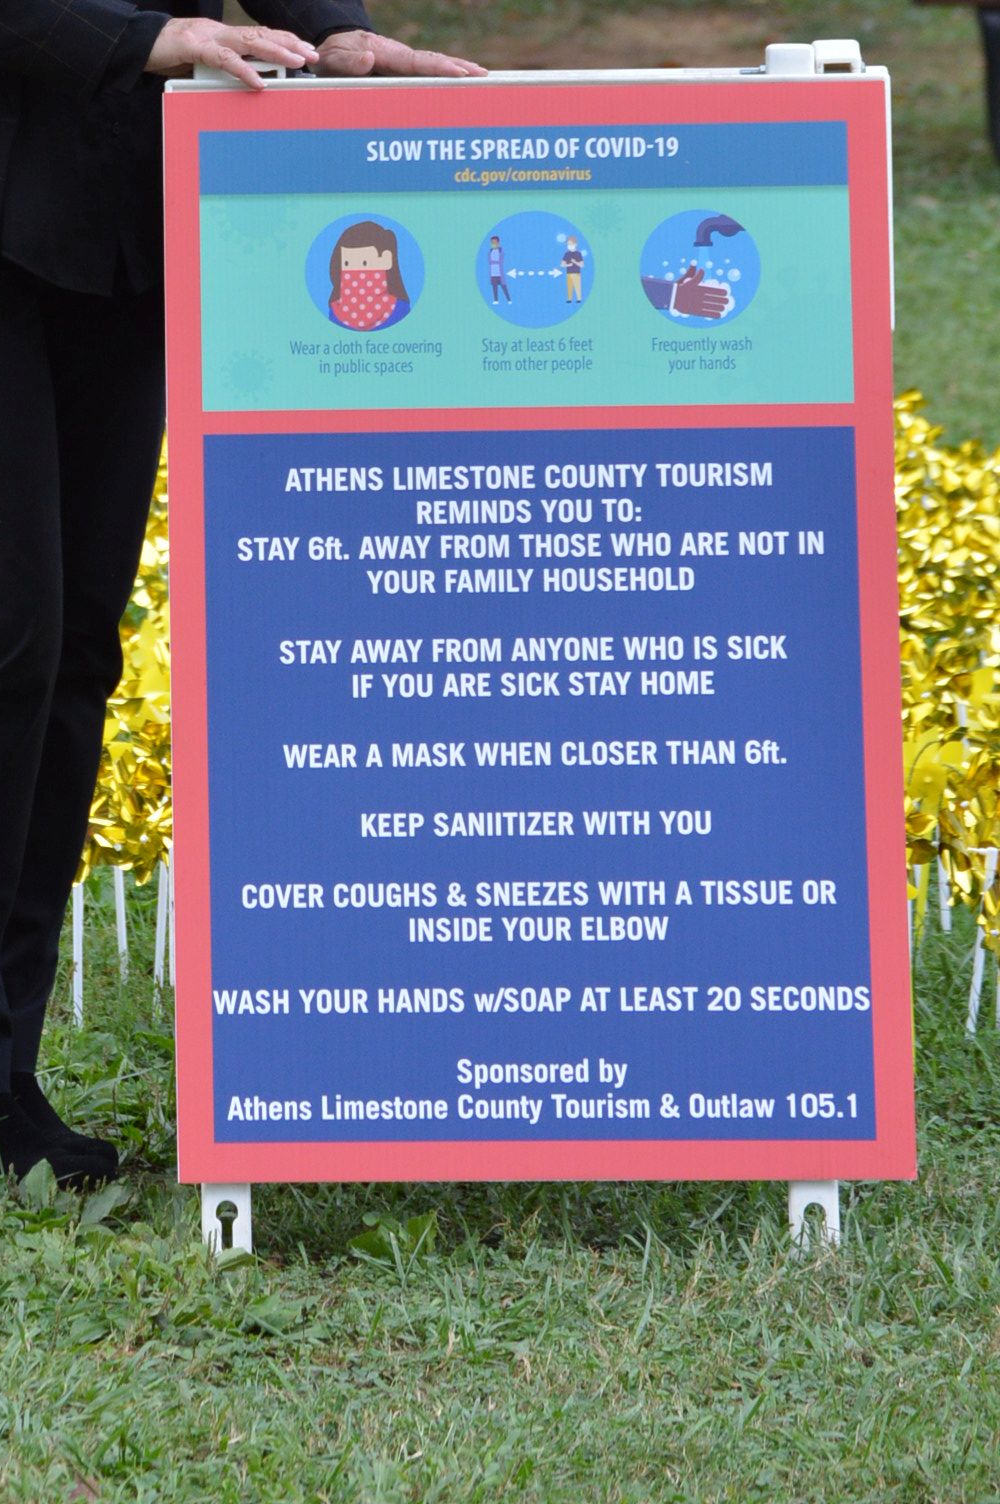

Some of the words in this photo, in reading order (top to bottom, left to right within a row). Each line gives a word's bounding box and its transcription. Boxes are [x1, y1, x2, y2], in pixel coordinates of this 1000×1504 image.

[366, 140, 423, 162] SLOW
[426, 139, 466, 161] THE
[470, 138, 550, 160] SPREAD
[554, 137, 580, 159] OF
[584, 136, 679, 159] COVID-19
[454, 167, 591, 185] cdc.gov/coronavirus
[290, 341, 321, 356] Wear
[324, 344, 330, 355] a
[333, 340, 363, 355] cloth
[365, 340, 390, 354] face
[393, 339, 443, 357] covering
[481, 338, 507, 355] Stay
[511, 340, 523, 353] at
[527, 338, 555, 353] least
[558, 338, 566, 352] 6
[569, 336, 593, 352] feet
[651, 337, 717, 355] Frequently
[720, 336, 753, 351] wash
[319, 360, 331, 374] in
[333, 359, 370, 377] public
[374, 360, 414, 376] spaces
[482, 357, 512, 372] from
[515, 357, 548, 371] other
[551, 357, 593, 374] people
[668, 360, 697, 375] your
[699, 356, 737, 371] hands
[285, 467, 383, 491] ATHENS
[394, 465, 535, 490] LIMESTONE
[545, 464, 647, 488] COUNTY
[656, 463, 772, 487] TOURISM
[417, 500, 531, 524] REMINDS
[541, 499, 592, 523] YOU
[601, 498, 641, 522] TO:
[238, 537, 299, 561] STAY
[309, 536, 349, 560] 6ft.
[359, 536, 431, 559] AWAY
[441, 535, 509, 558] FROM
[519, 533, 601, 557] THOSE
[610, 532, 671, 556] WHO
[680, 532, 729, 556] ARE
[739, 531, 789, 555] NOT
[799, 531, 824, 554] IN
[367, 570, 435, 594] YOUR
[445, 569, 533, 593] FAMILY
[544, 567, 694, 592] HOUSEHOLD
[280, 640, 342, 664] STAY
[351, 639, 423, 663] AWAY
[432, 638, 501, 662] FROM
[511, 637, 614, 661] ANYONE
[623, 636, 683, 660] WHO
[694, 636, 717, 660] IS
[728, 635, 787, 659] SICK
[353, 674, 373, 698] IF
[382, 674, 433, 697] YOU
[443, 673, 491, 697] ARE
[501, 672, 560, 696] SICK
[569, 672, 631, 696] STAY
[641, 671, 714, 695] HOME
[283, 744, 357, 768] WEAR
[366, 744, 382, 767] A
[392, 743, 466, 767] MASK
[474, 742, 551, 766] WHEN
[561, 741, 657, 765] CLOSER
[666, 740, 735, 764] THAN
[745, 740, 786, 764] 6ft.
[361, 813, 424, 837] KEEP
[583, 811, 650, 835] WITH
[659, 810, 711, 835] YOU
[242, 884, 324, 909] COVER
[334, 883, 437, 908] COUGHS
[447, 882, 467, 907] &
[476, 881, 588, 906] SNEEZES
[598, 881, 665, 905] WITH
[675, 881, 692, 905] A
[700, 880, 793, 905] TISSUE
[803, 880, 836, 904] OR
[409, 917, 492, 942] INSIDE
[502, 917, 571, 941] YOUR
[581, 916, 668, 941] ELBOW
[213, 989, 289, 1014] WASH
[299, 989, 368, 1013] YOUR
[378, 988, 464, 1013] HANDS
[474, 987, 571, 1012] w/SOAP
[580, 987, 611, 1011] AT
[620, 987, 698, 1011] LEAST
[707, 986, 741, 1011] 20
[751, 986, 870, 1011] SECONDS
[457, 1058, 589, 1089] Sponsored
[599, 1058, 627, 1088] by
[228, 1096, 312, 1121] Athens
[322, 1094, 448, 1120] Limestone
[458, 1094, 542, 1124] County
[551, 1093, 650, 1118] Tourism
[660, 1093, 680, 1118] &
[689, 1093, 775, 1118] Outlaw
[787, 1093, 857, 1118] 105.1
